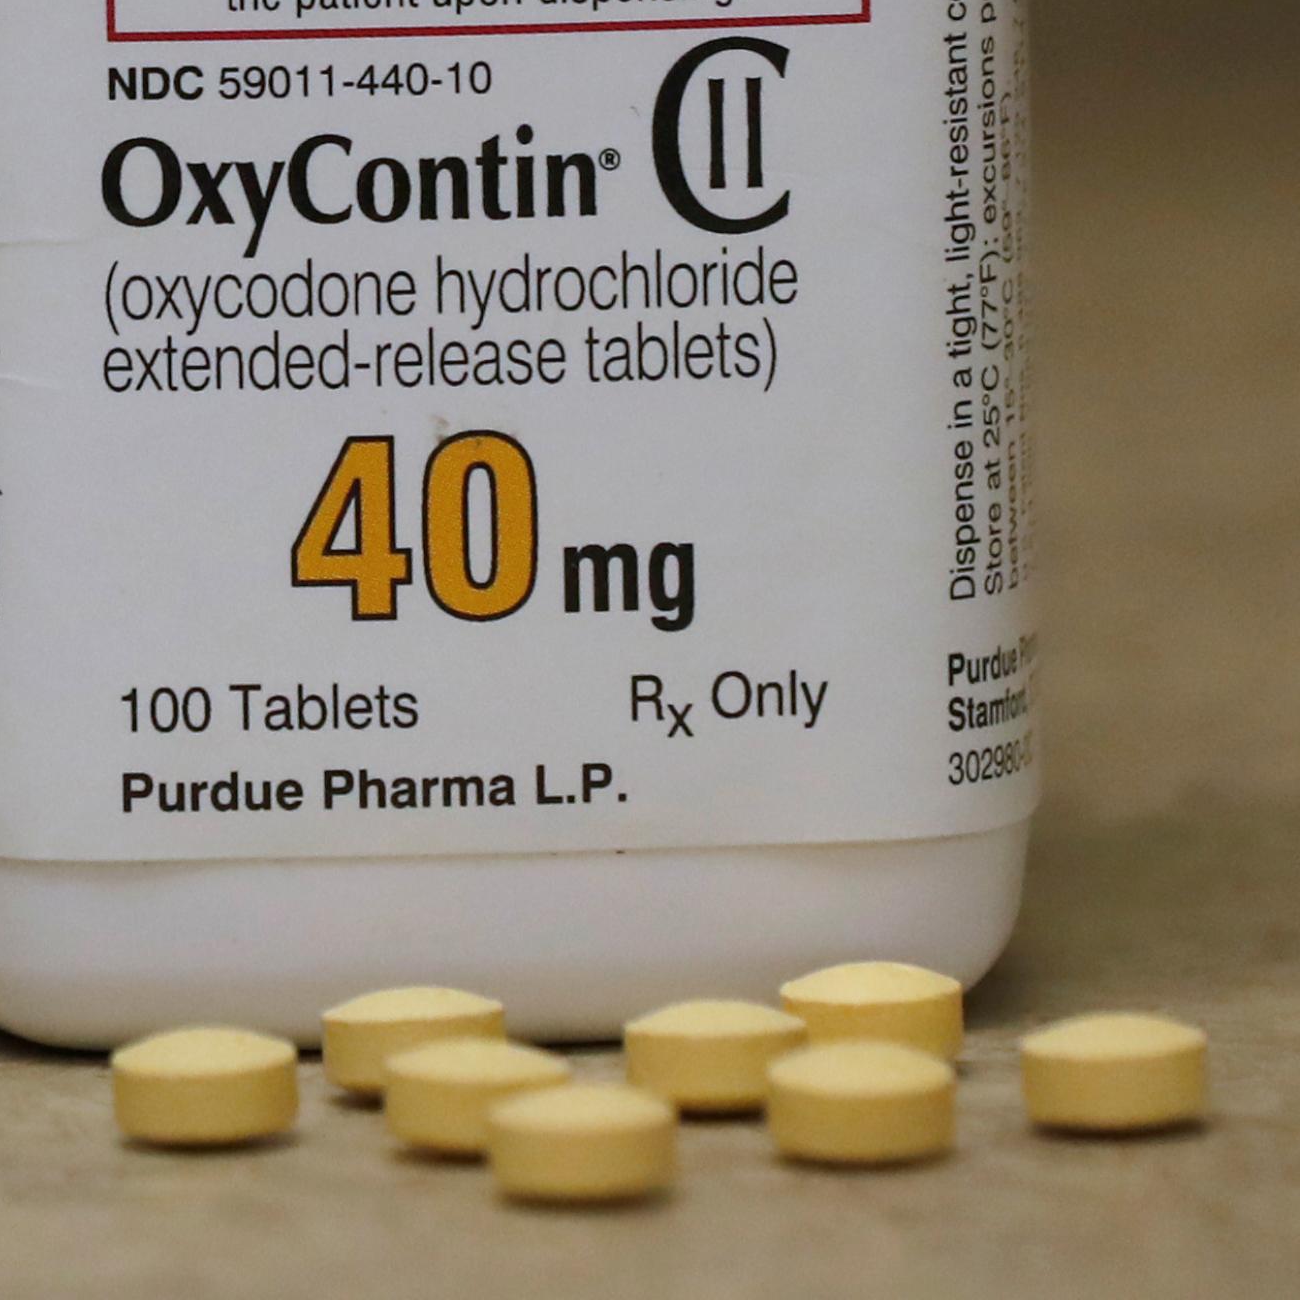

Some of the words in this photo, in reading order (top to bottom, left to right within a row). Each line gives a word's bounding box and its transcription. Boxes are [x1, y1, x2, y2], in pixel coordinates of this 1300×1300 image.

[108, 66, 203, 101] NDC
[218, 61, 491, 99] 59011-440-10
[943, 31, 976, 263] light-resistant
[977, 35, 997, 225] excursions
[104, 259, 416, 336] (oxycodone
[436, 247, 798, 329] hydrochloride
[946, 272, 977, 360] tight,
[103, 329, 566, 392] extended-release
[586, 317, 777, 392] tablets)
[953, 367, 973, 389] a
[948, 399, 973, 429] in
[984, 458, 1001, 490] at
[291, 429, 538, 621] 40
[564, 542, 695, 632] mg
[950, 440, 980, 601] Dispense
[984, 502, 1002, 595] Store
[948, 646, 1017, 686] Purdue
[121, 686, 211, 733] 100
[230, 684, 419, 731] Tablets
[630, 675, 694, 737] Rx
[711, 671, 828, 727] Only
[122, 773, 302, 813] Purdue
[324, 770, 514, 809] Pharma
[535, 762, 628, 805] L.P.
